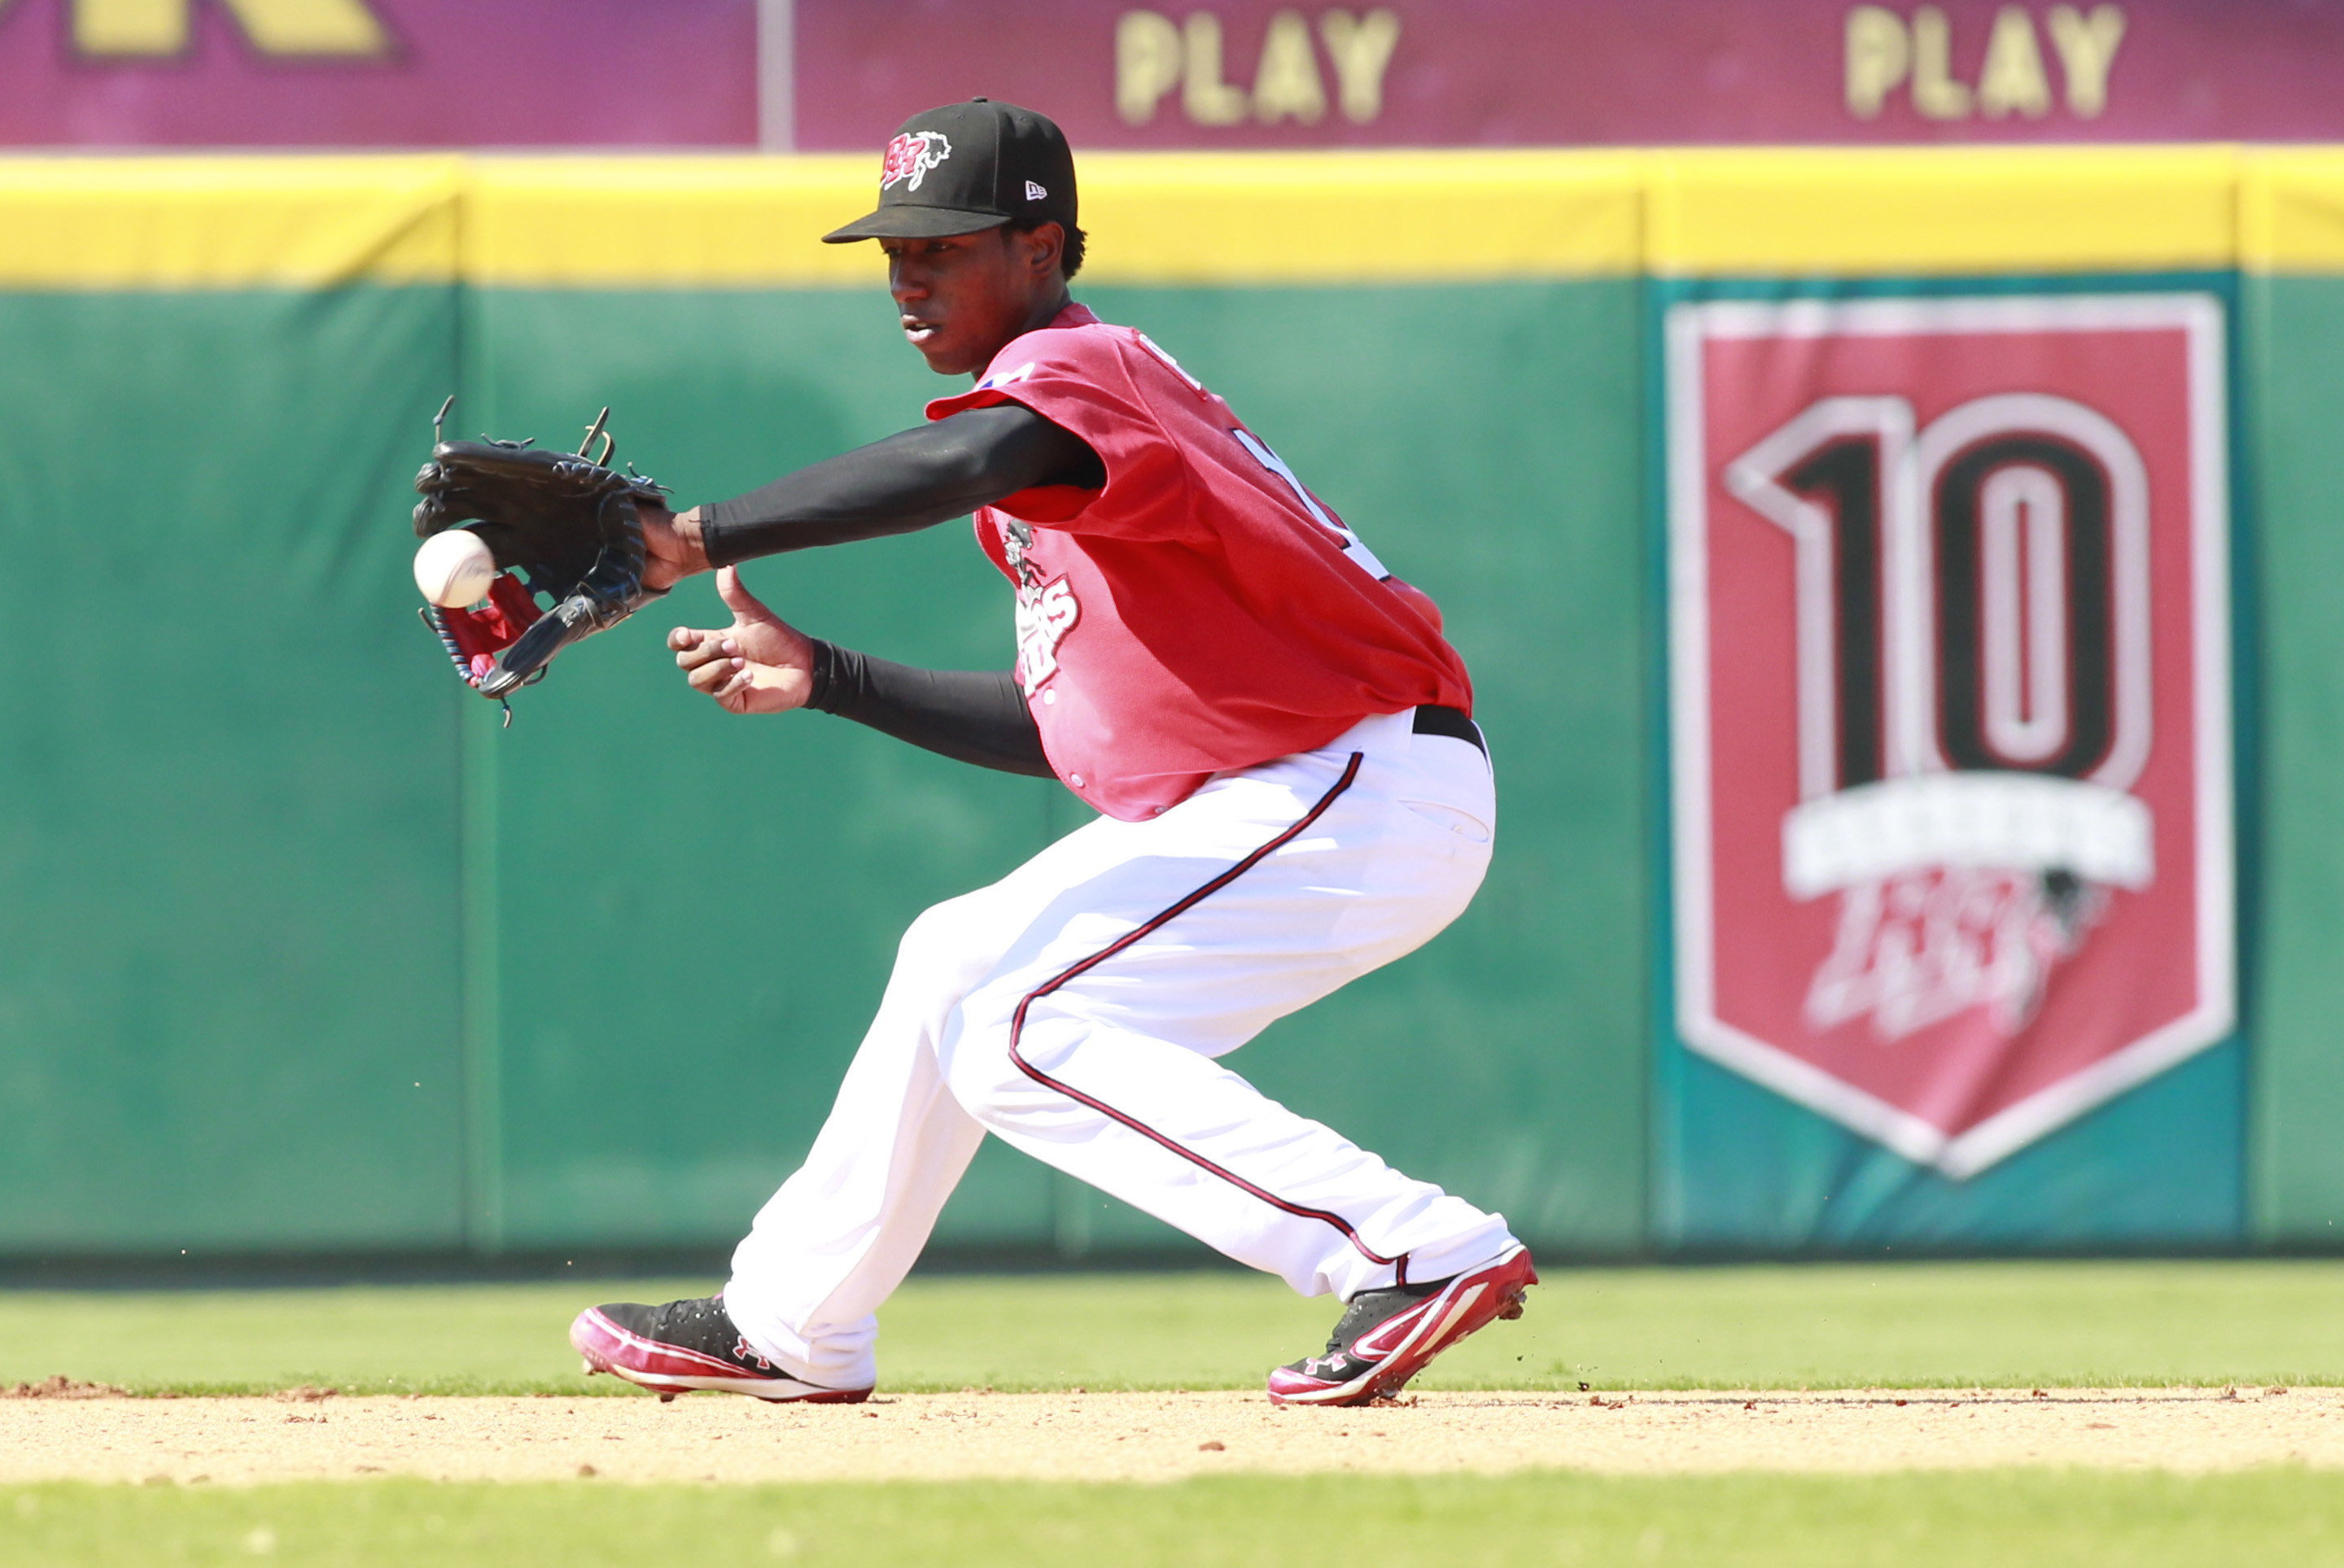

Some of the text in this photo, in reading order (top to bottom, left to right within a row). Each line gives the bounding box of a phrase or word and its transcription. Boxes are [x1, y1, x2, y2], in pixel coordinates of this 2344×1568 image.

[1116, 9, 1400, 126] PLAY
[1844, 3, 2126, 121] PLAY
[1726, 393, 2153, 801] 10
